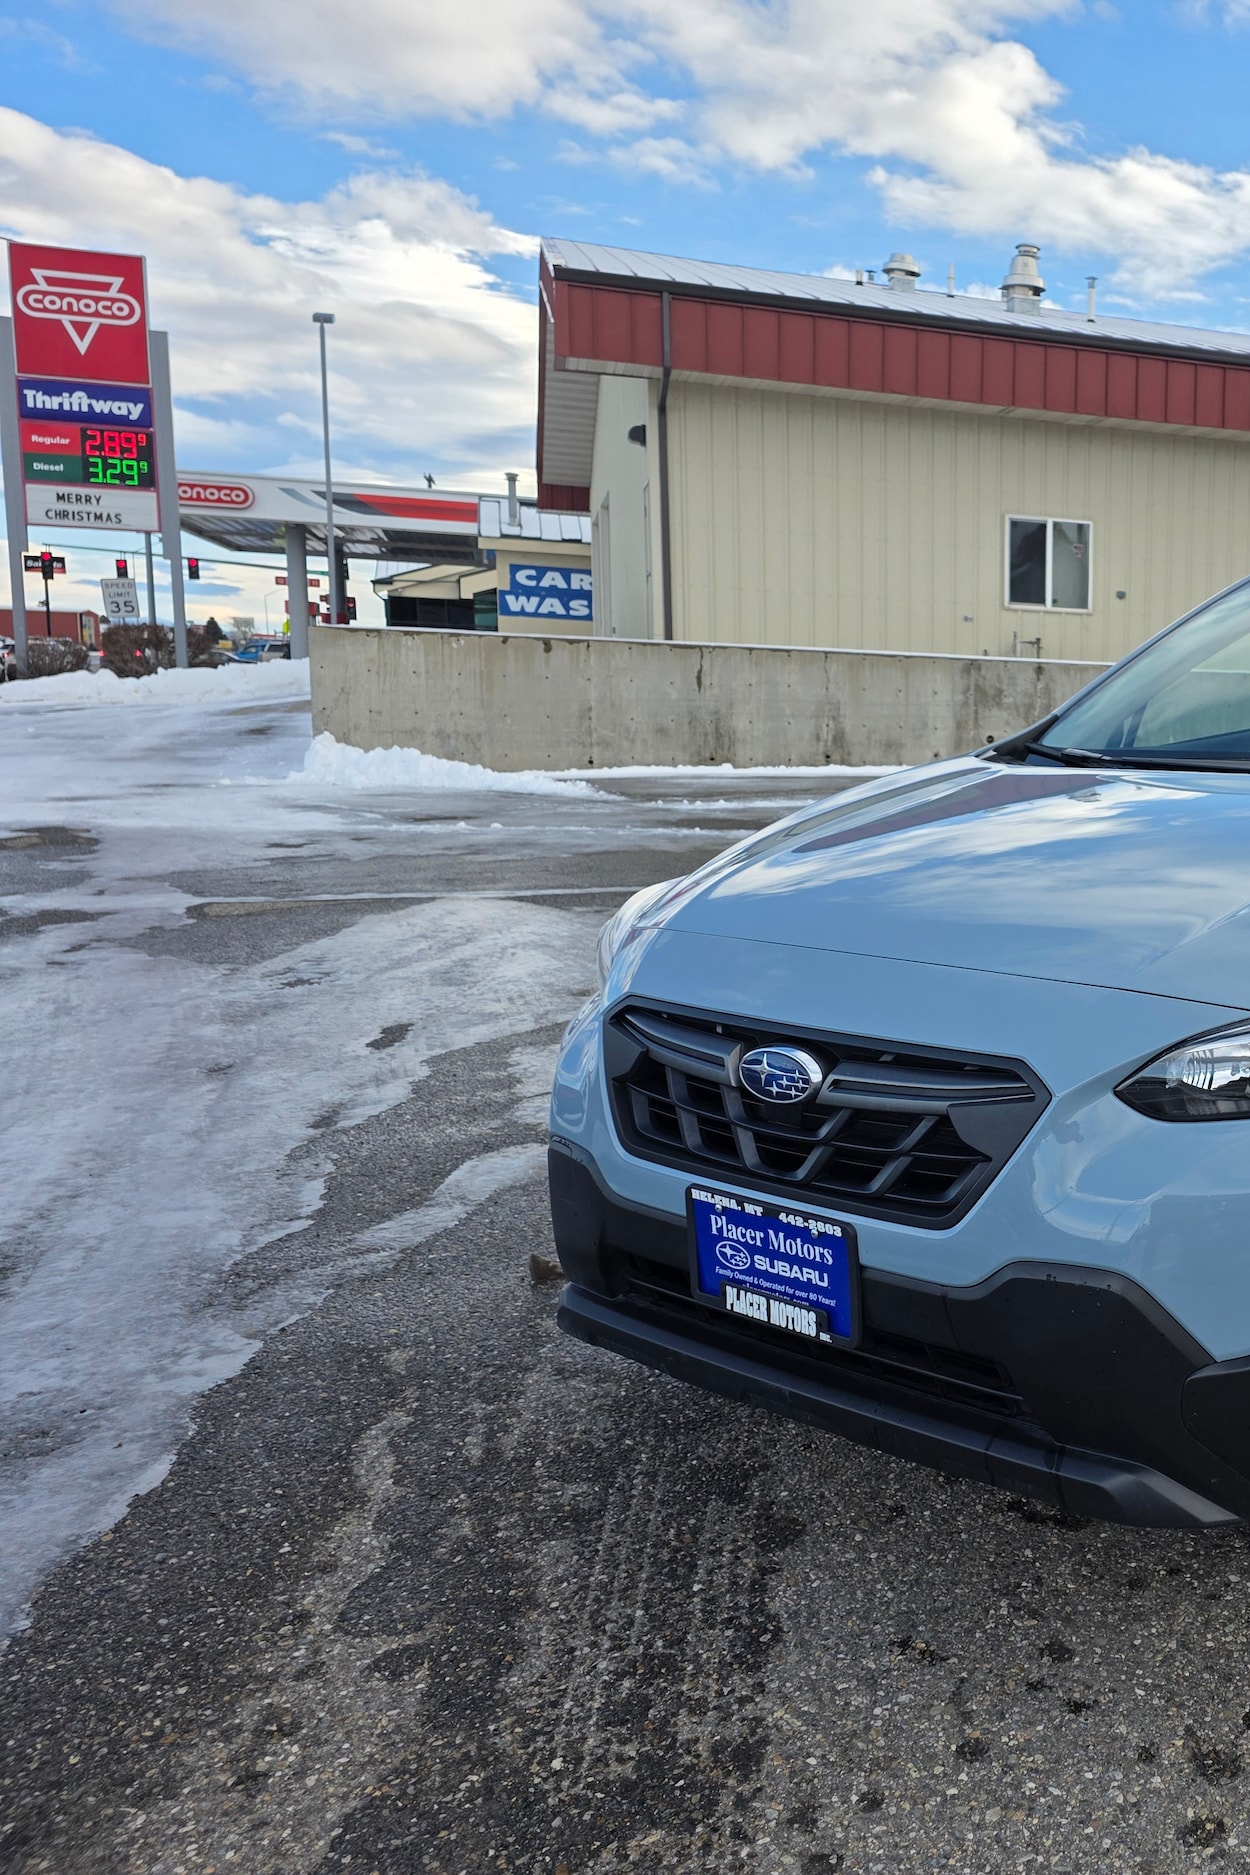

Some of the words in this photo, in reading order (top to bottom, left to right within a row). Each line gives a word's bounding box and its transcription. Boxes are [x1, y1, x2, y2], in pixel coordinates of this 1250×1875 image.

[23, 389, 144, 420] Thriftway
[31, 434, 70, 445] Regular
[33, 462, 64, 472] Diesel
[56, 492, 102, 506] MERRY
[178, 485, 245, 502] onoco
[45, 508, 122, 524] CHRISTMAS
[515, 569, 592, 591] CAR
[110, 601, 135, 613] 35
[505, 594, 590, 616] WAS
[743, 1202, 764, 1217] MT
[710, 1214, 765, 1247] Placer
[767, 1229, 834, 1266] Motors
[754, 1254, 829, 1288] SUBARU
[715, 1266, 735, 1279] Family
[734, 1271, 754, 1284] Owned
[759, 1278, 786, 1294] Operated
[785, 1285, 795, 1295] for
[794, 1290, 809, 1299] over
[818, 1294, 837, 1307] Years!
[725, 1285, 769, 1323] PLACER
[769, 1298, 817, 1338] MOTORS
